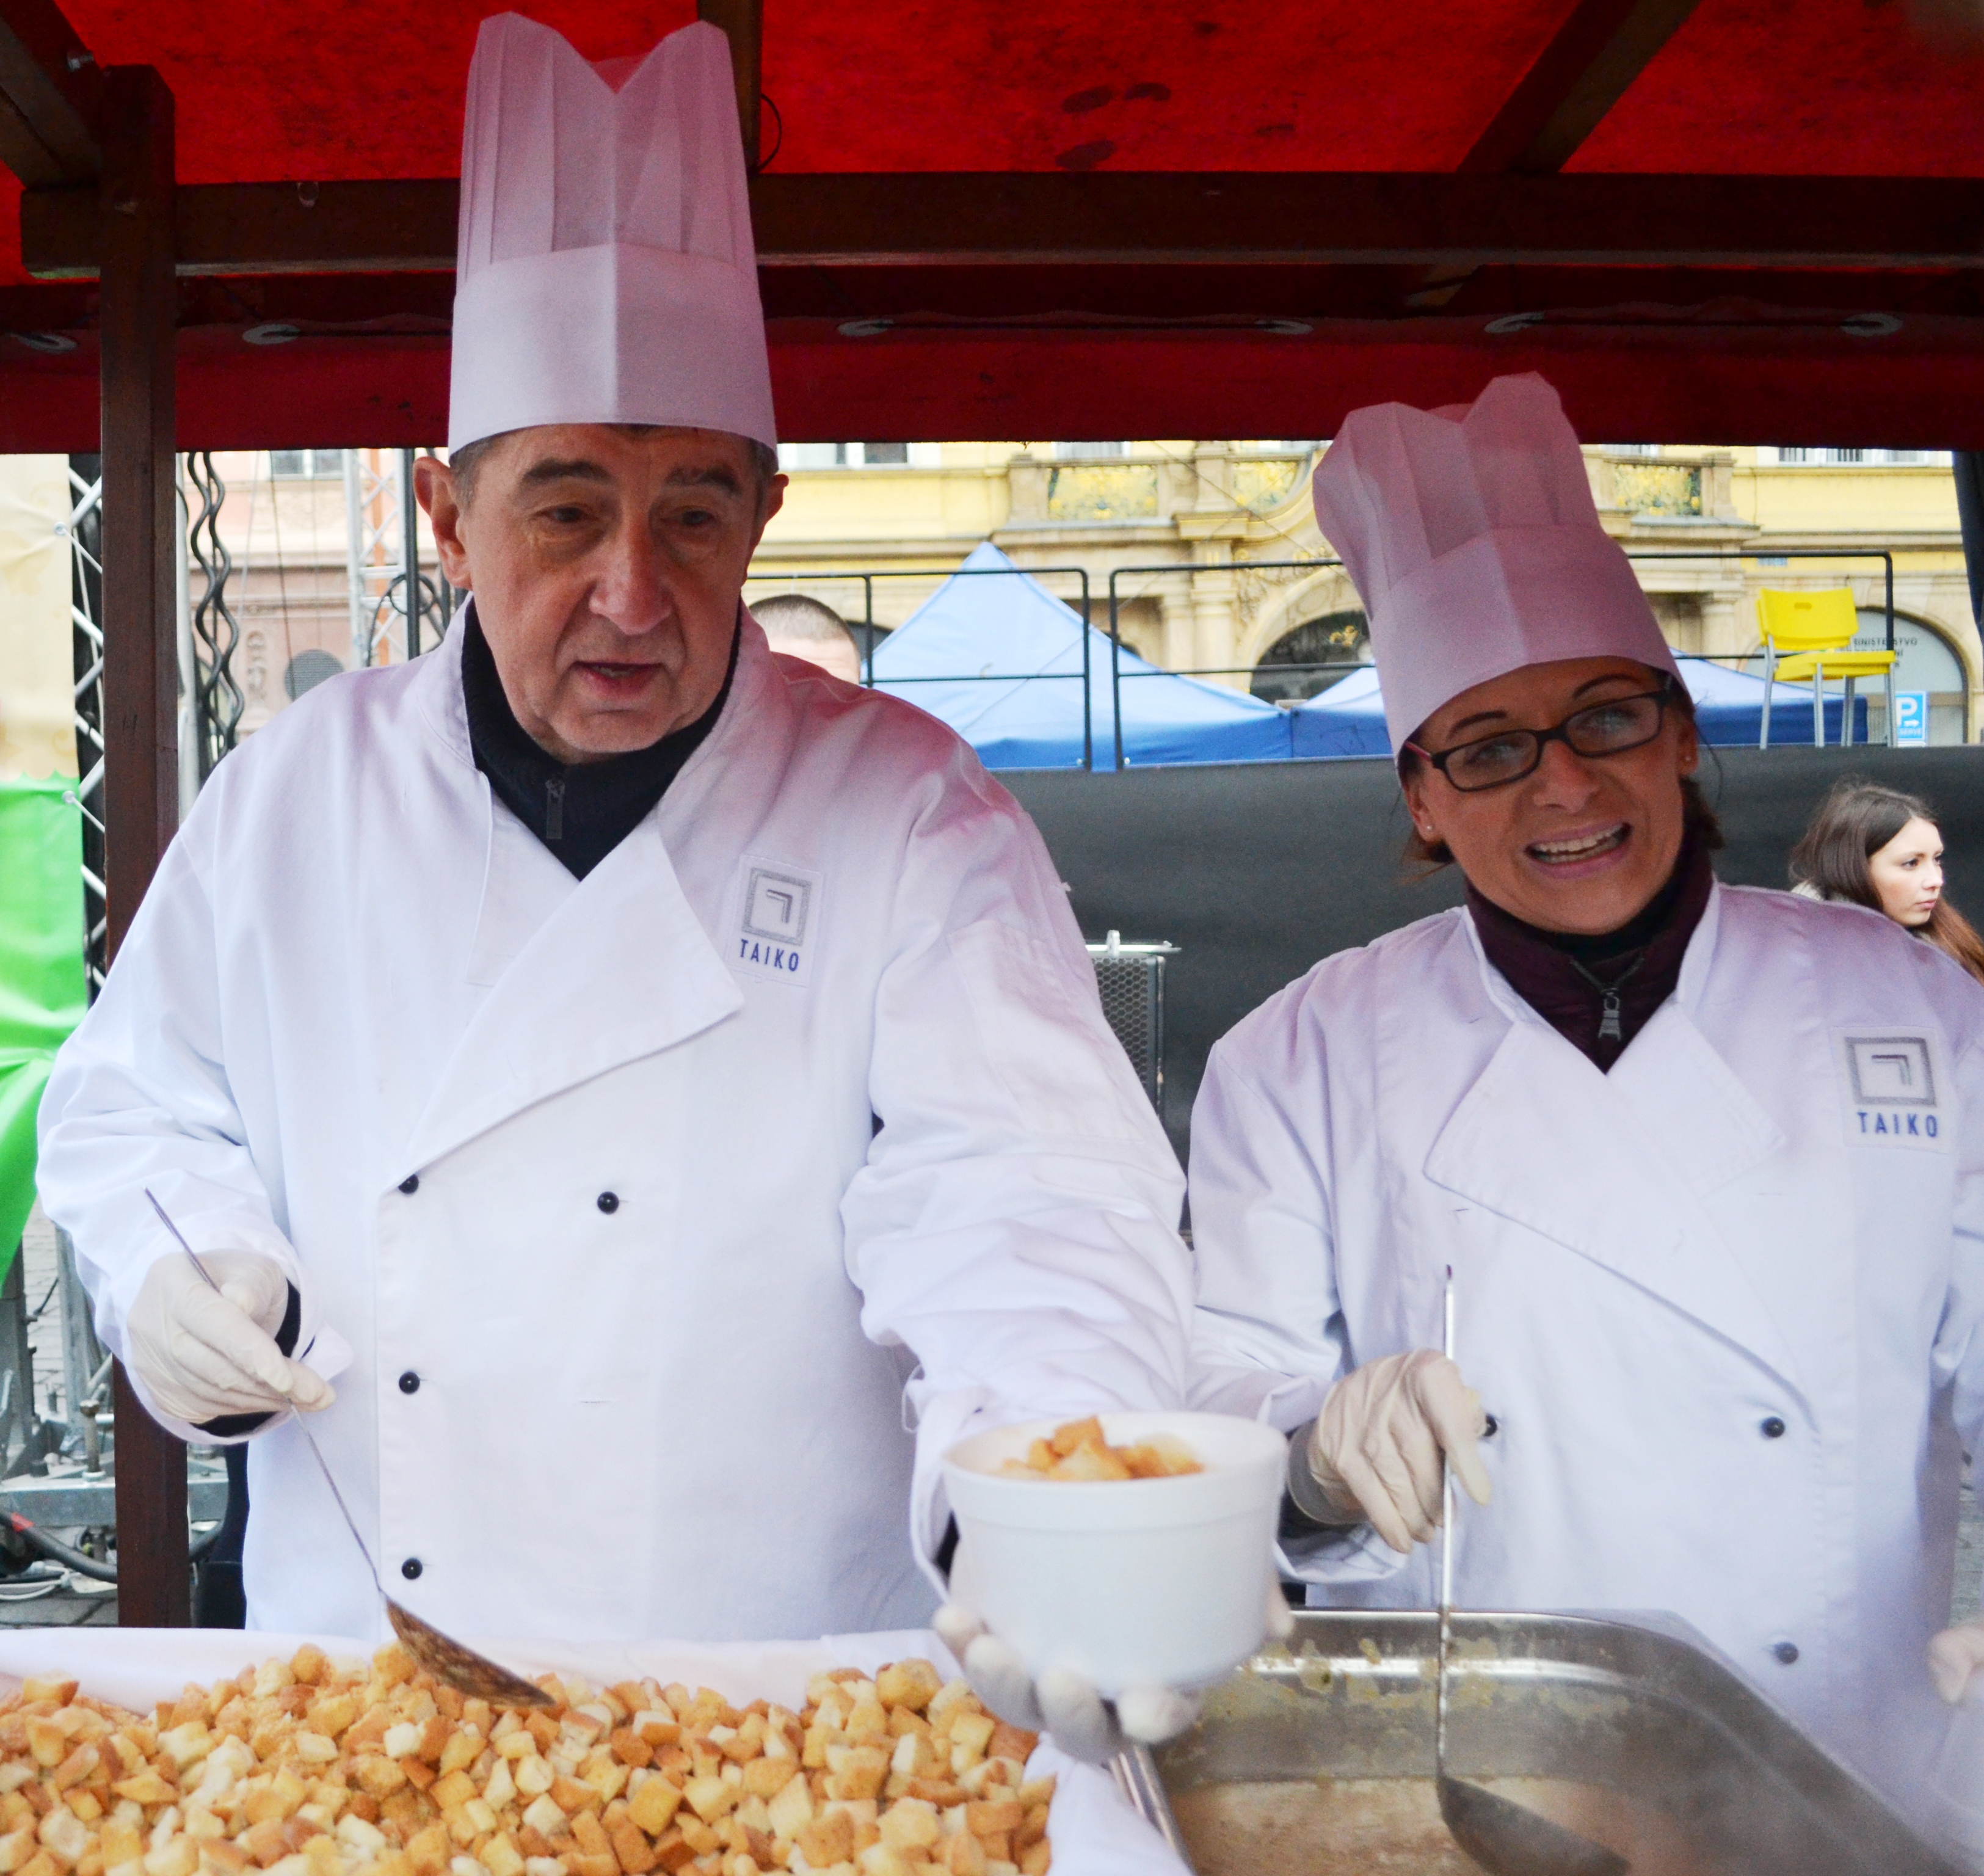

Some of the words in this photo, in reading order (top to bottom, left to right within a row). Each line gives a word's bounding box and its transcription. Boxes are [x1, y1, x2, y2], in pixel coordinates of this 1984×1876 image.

[1895, 697, 1917, 725] P
[740, 939, 799, 972] TAIKO
[1858, 1112, 1937, 1137] TAIKO
